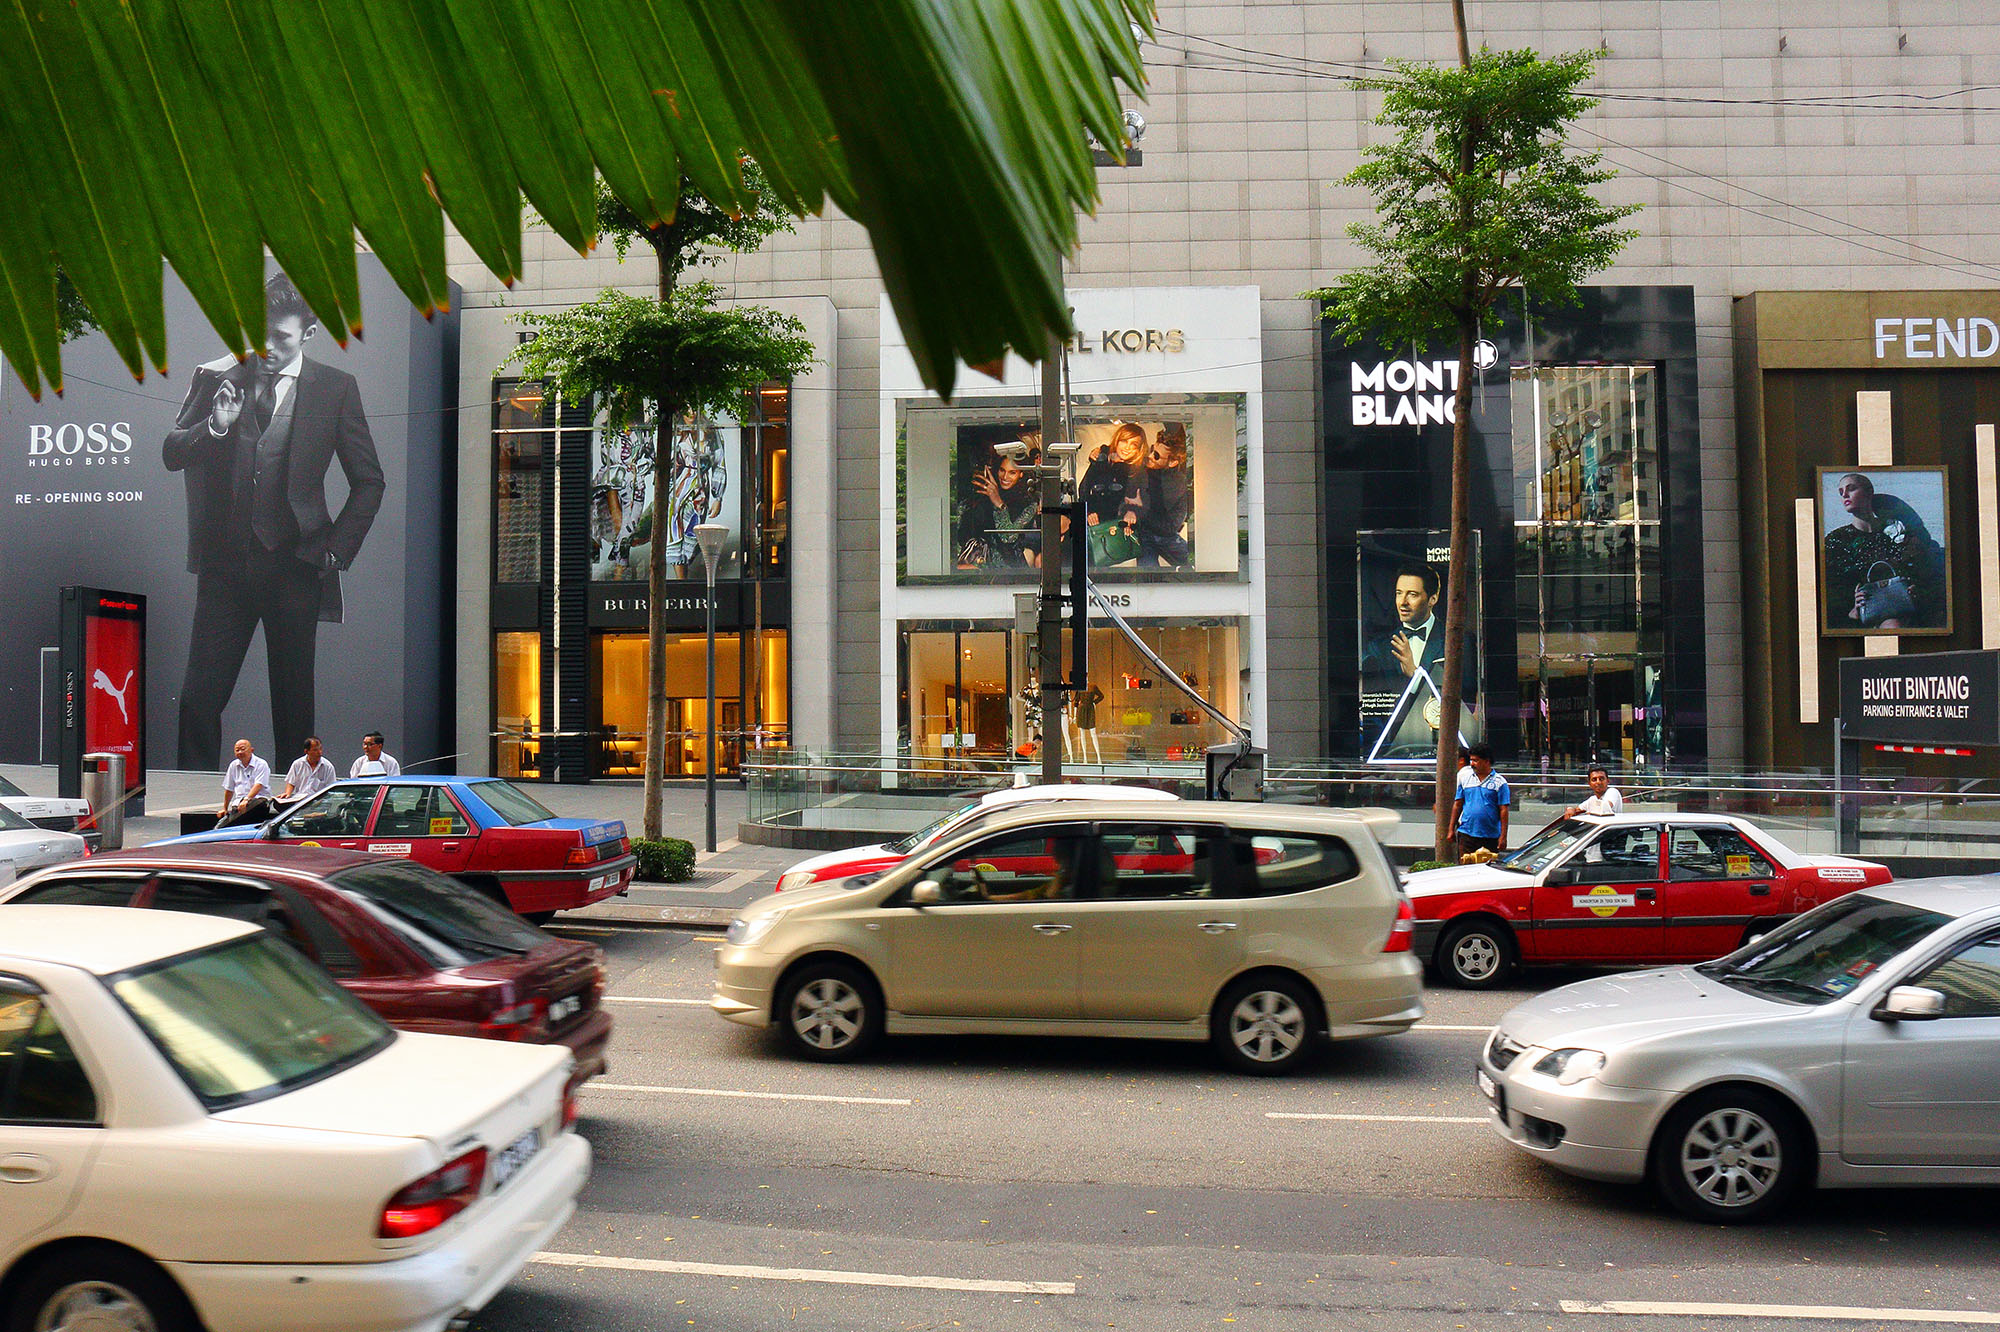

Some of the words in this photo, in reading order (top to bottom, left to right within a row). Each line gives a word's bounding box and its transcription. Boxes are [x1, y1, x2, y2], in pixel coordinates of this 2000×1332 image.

[1102, 329, 1185, 353] KORS
[1351, 360, 1460, 392] MONT
[28, 421, 132, 455] BOSS
[28, 457, 73, 467] HUGO
[85, 456, 131, 466] BOSS
[15, 494, 31, 504] RE
[44, 492, 102, 503] OPENING
[106, 491, 143, 502] SOON
[604, 599, 718, 611] BURERR
[1088, 594, 1131, 607] KRS
[1862, 677, 1902, 700] BUKIT
[1905, 675, 1970, 700] BINTANG
[1863, 704, 1894, 717] PARKING
[1895, 704, 1935, 718] ENTRANCE
[1936, 705, 1943, 718] &
[1944, 705, 1970, 719] VALET
